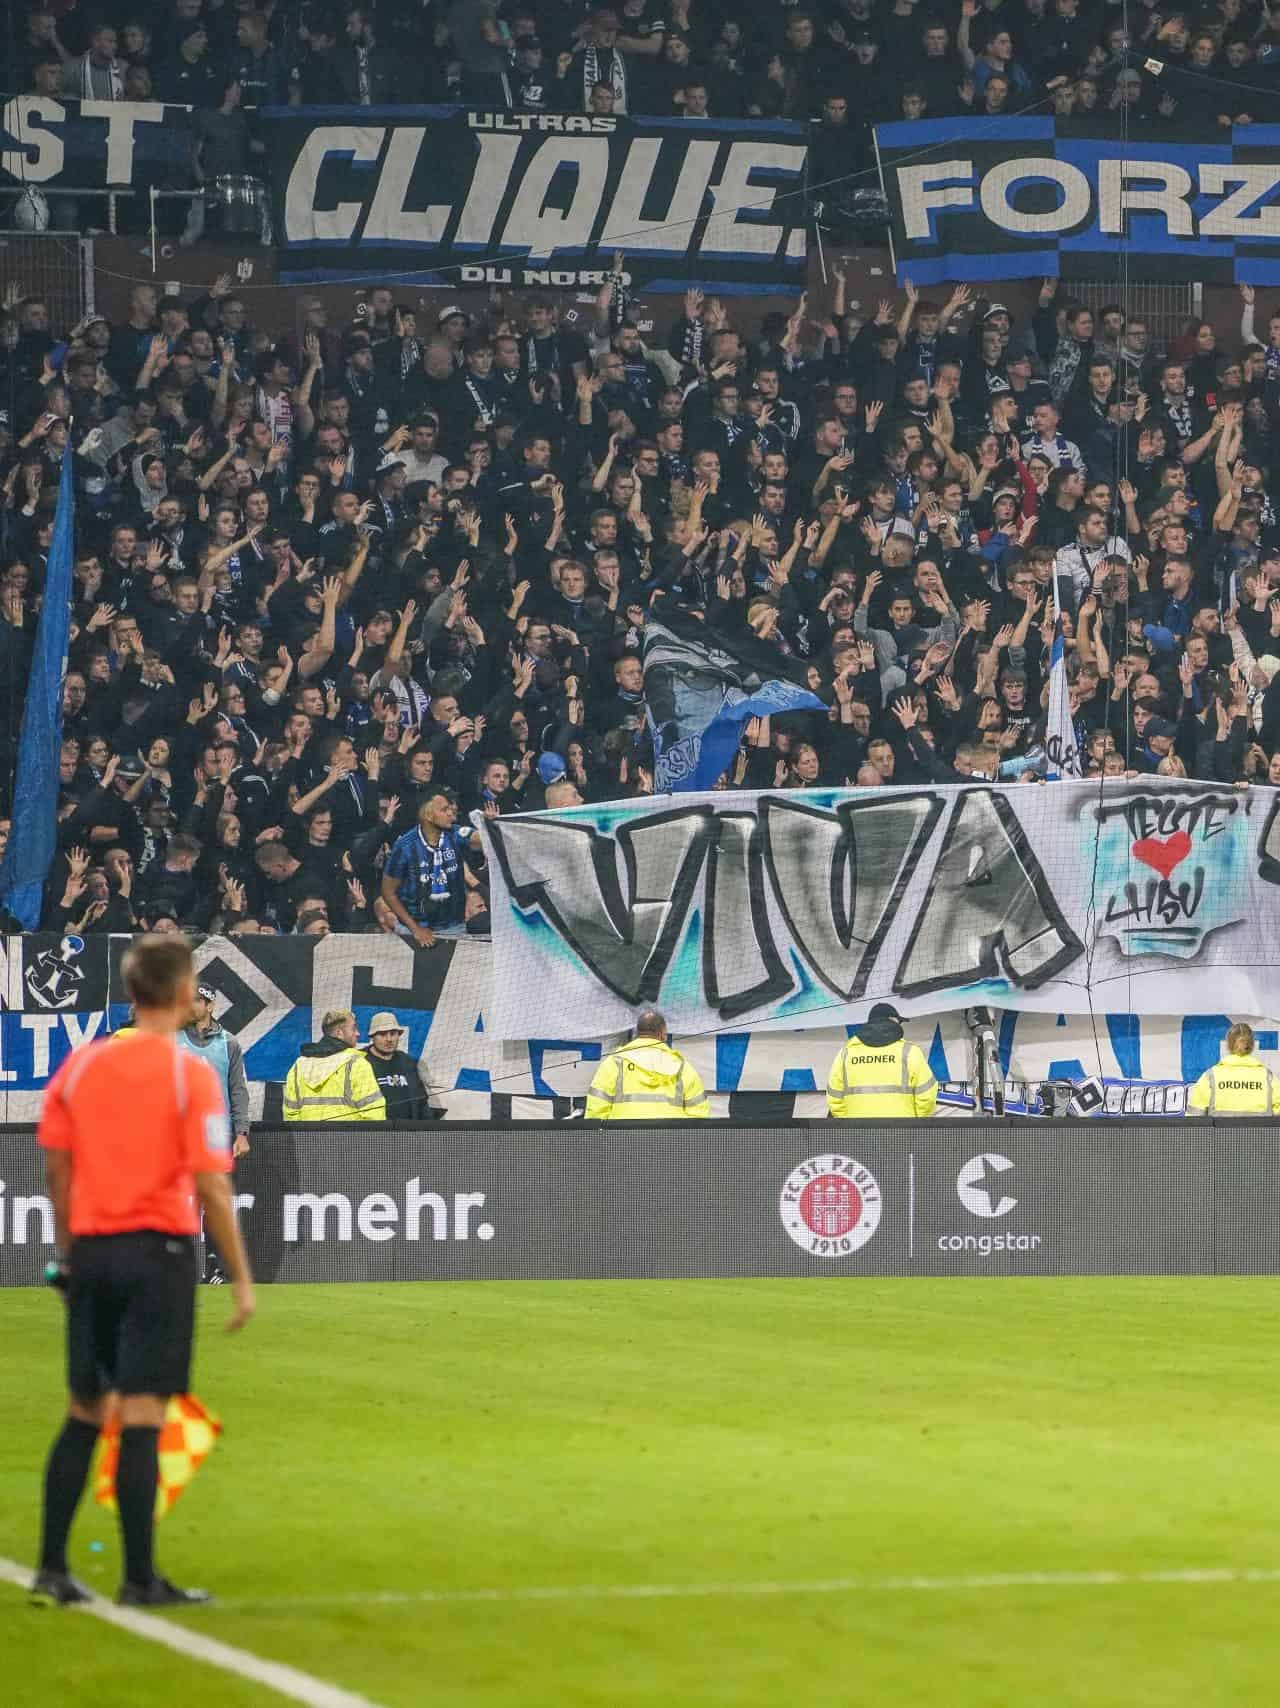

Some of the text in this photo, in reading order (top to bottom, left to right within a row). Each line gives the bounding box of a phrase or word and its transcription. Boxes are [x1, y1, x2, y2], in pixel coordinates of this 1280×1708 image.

[467, 112, 617, 132] ULTRAS
[460, 265, 512, 283] DU
[491, 787, 1087, 1020] VIVA
[850, 1054, 897, 1065] ORDNER
[1216, 1080, 1263, 1091] ORDNER
[831, 1157, 880, 1203] PAULI
[284, 1177, 496, 1243] mehr.
[810, 1238, 851, 1254] 1910
[937, 1231, 1042, 1256] congstar
